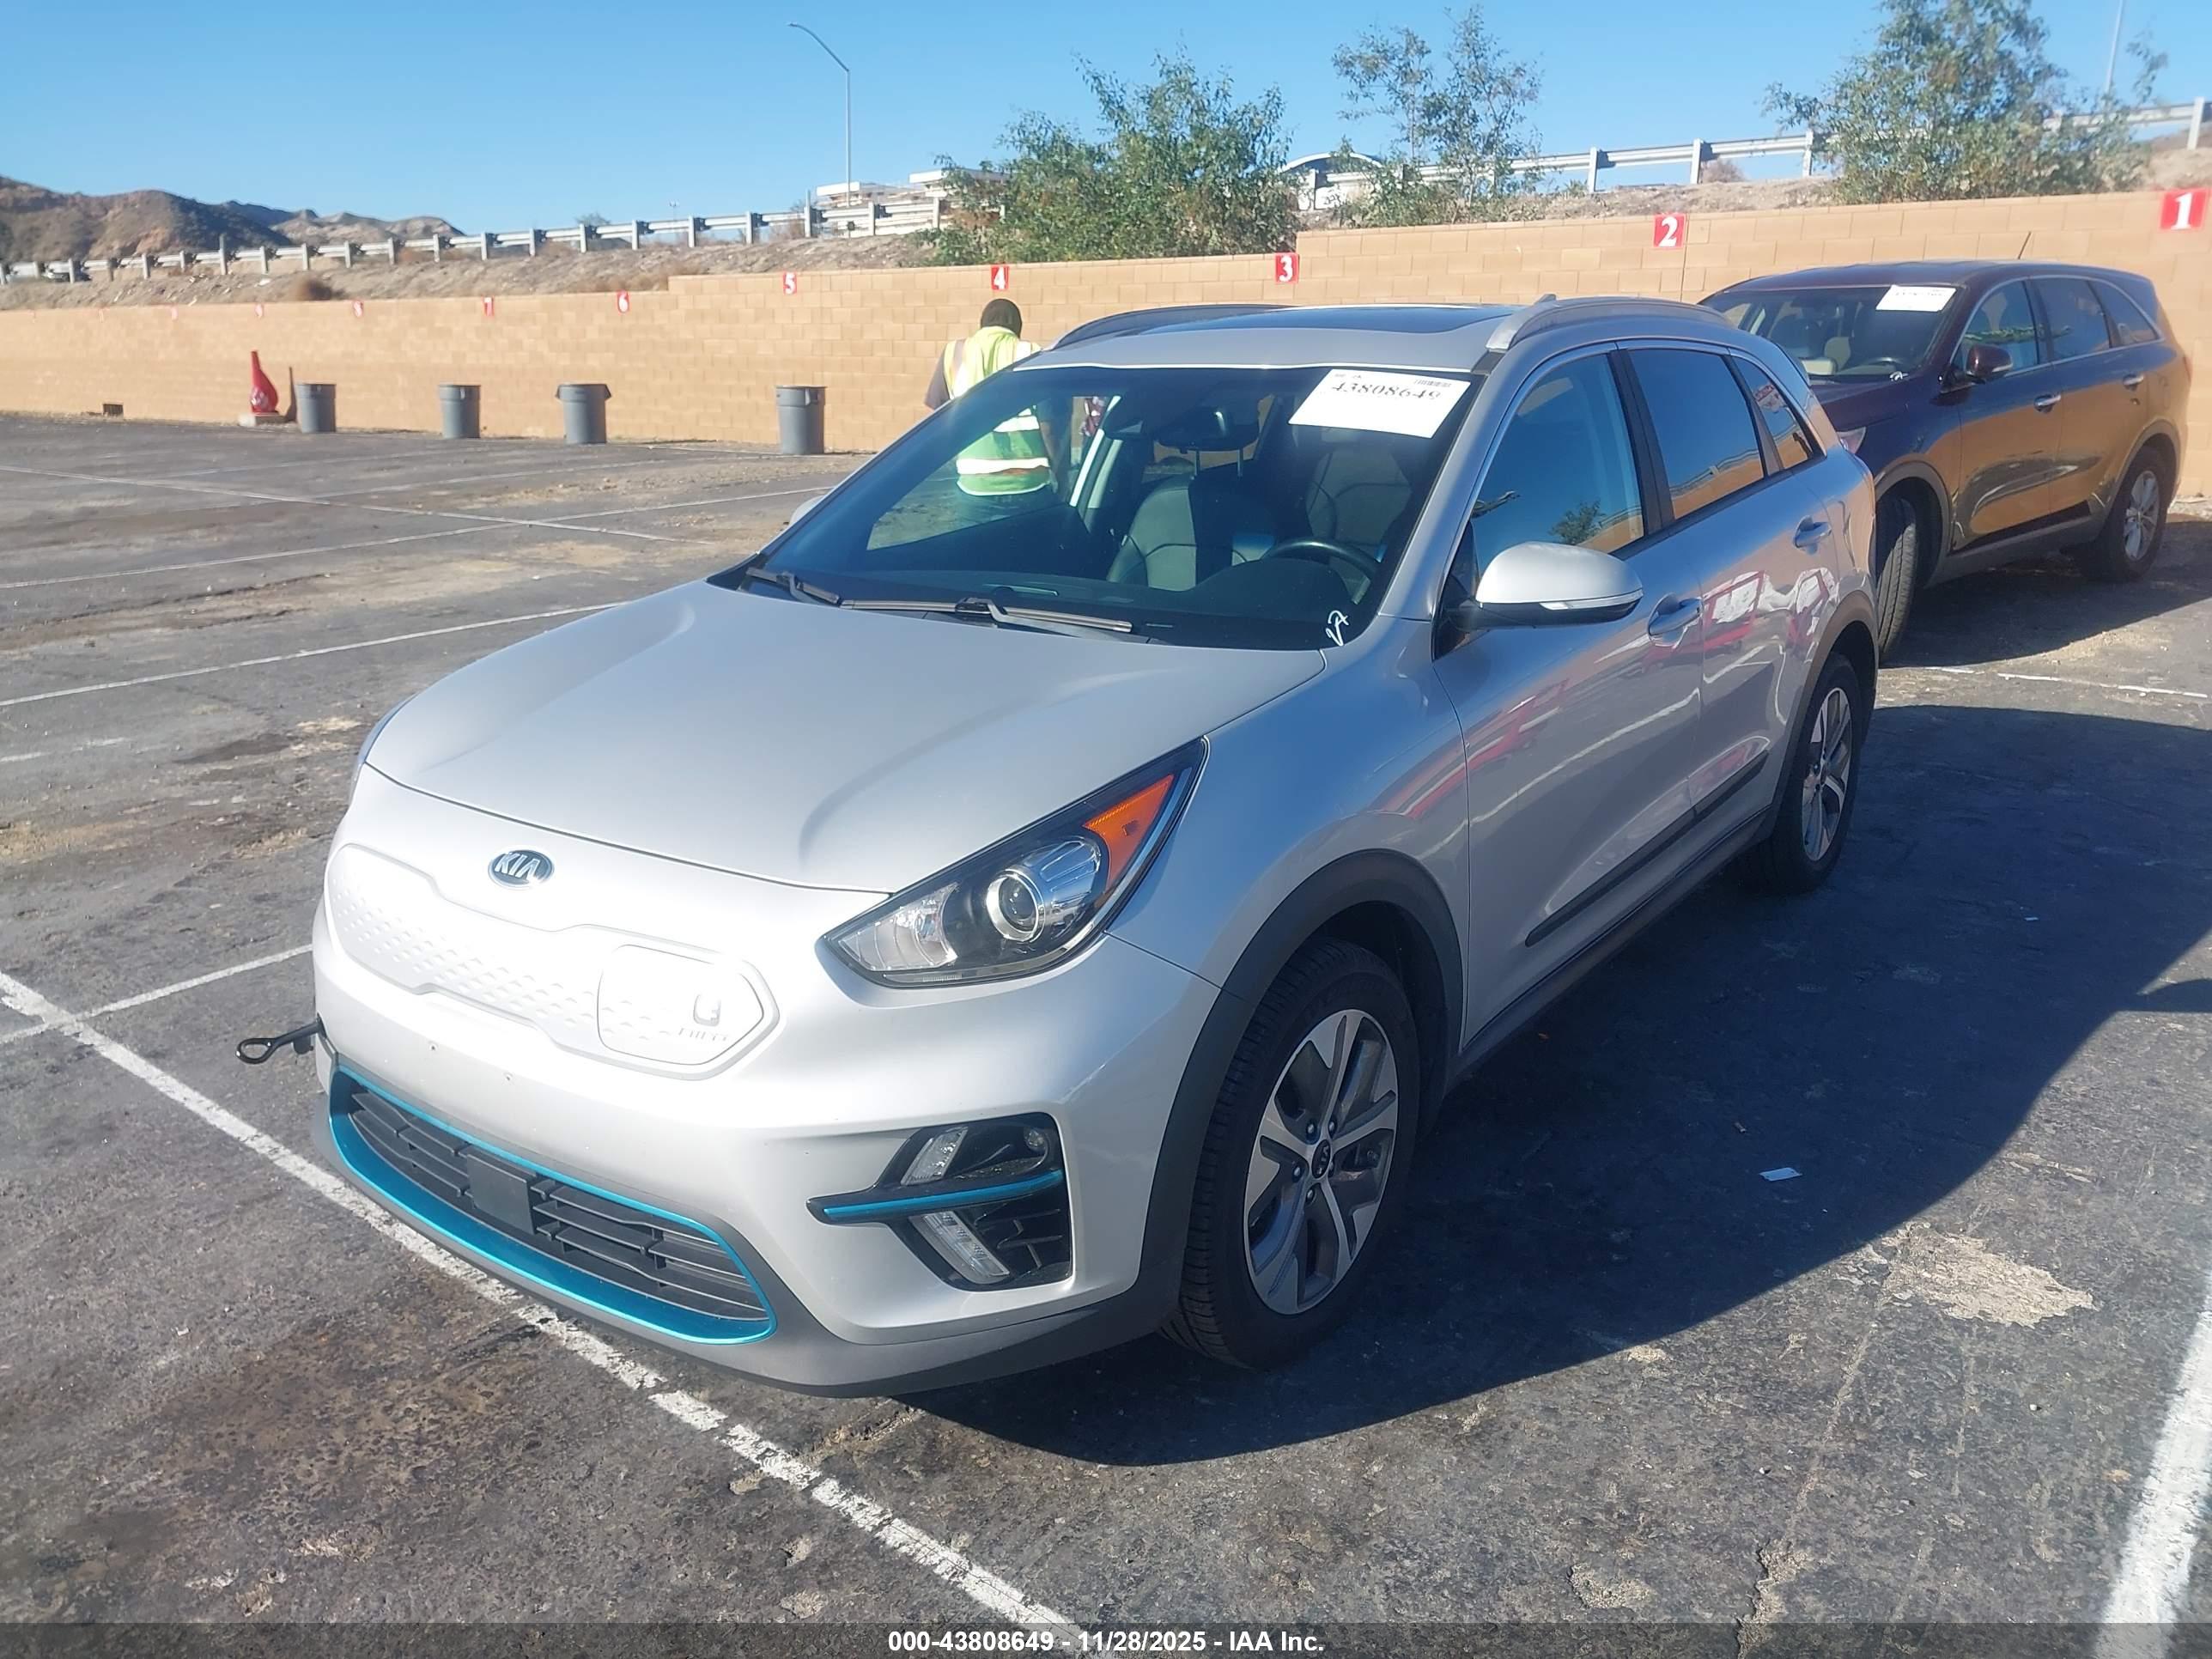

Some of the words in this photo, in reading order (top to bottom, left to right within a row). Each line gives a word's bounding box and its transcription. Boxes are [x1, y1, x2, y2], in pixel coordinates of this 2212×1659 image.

[2171, 191, 2192, 230] 1
[1658, 216, 1678, 247] 2
[785, 272, 795, 294] 5
[994, 265, 1006, 290] 4
[1279, 255, 1293, 283] 3
[494, 852, 541, 881] KIA
